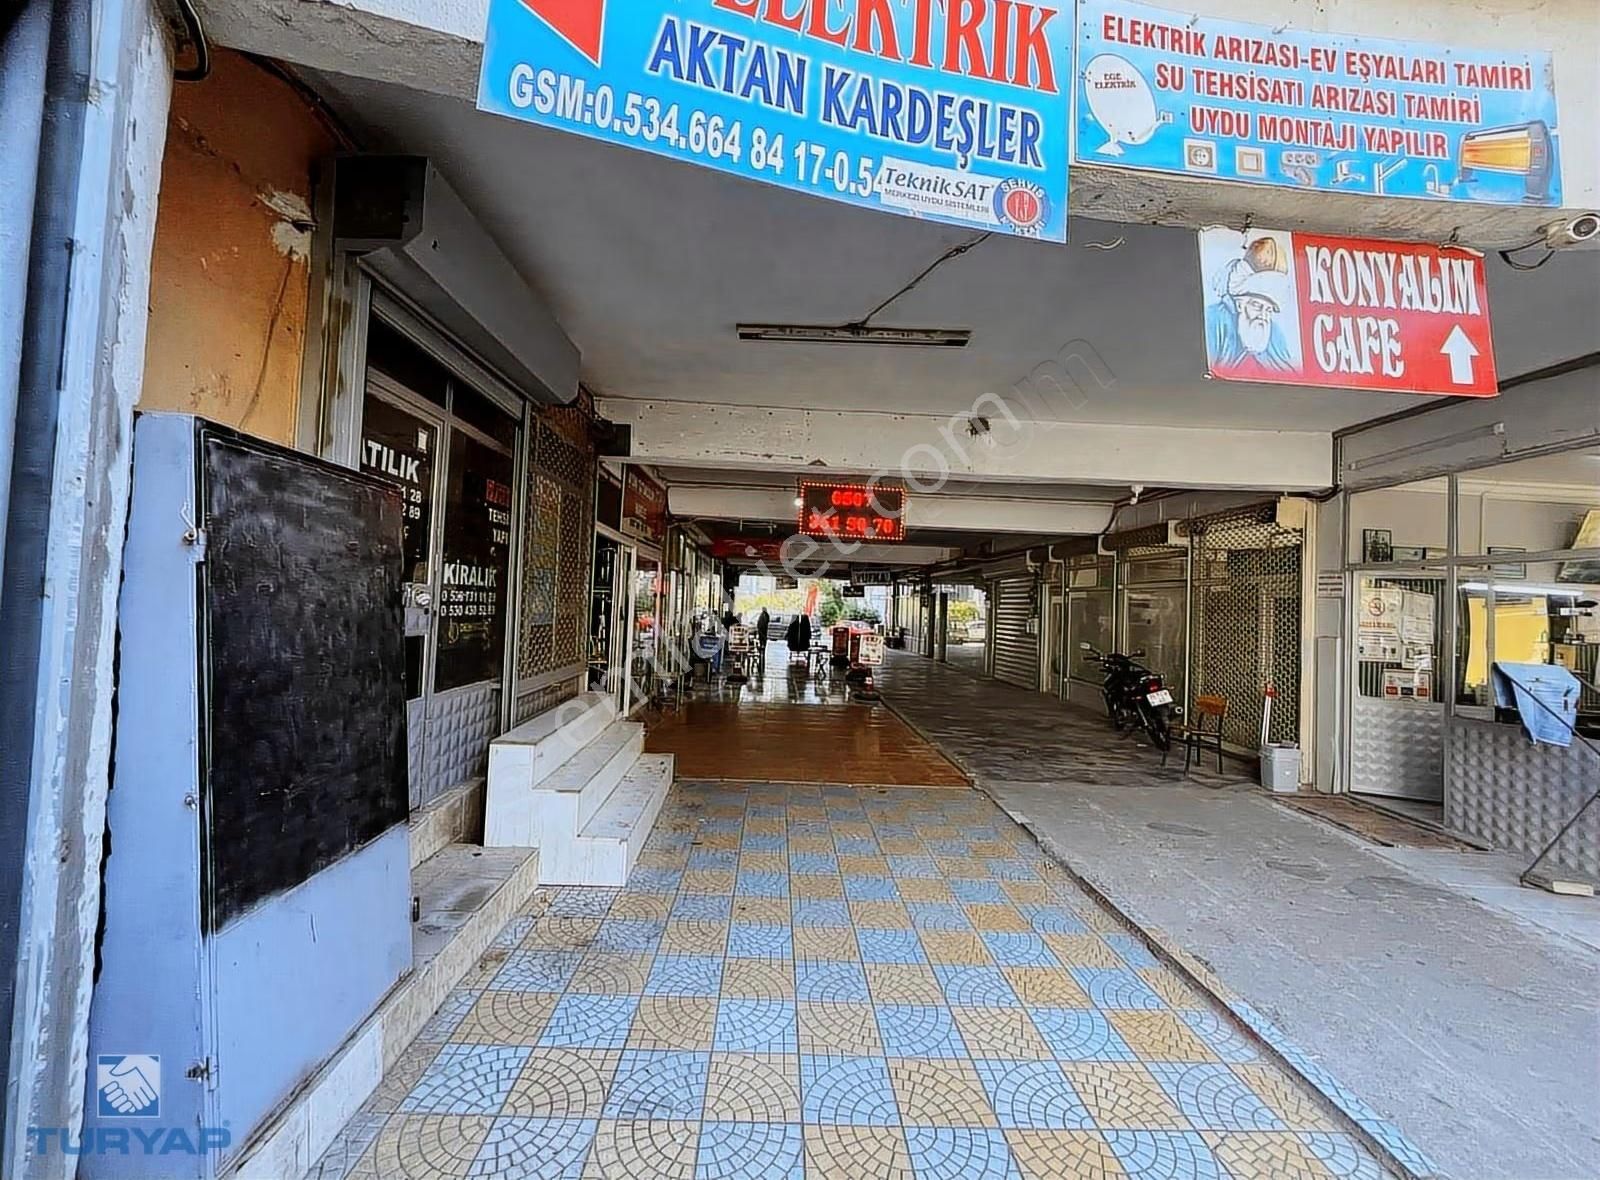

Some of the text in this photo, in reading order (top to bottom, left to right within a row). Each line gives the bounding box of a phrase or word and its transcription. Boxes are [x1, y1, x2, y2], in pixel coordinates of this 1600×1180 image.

[713, 0, 1058, 93] EKTRIK
[1103, 15, 1532, 90] ELEKTRİK ARIZASI-EV EŞYALARI TAMİRİ
[509, 63, 742, 163] GSM:0.534.664
[751, 127, 784, 175] 84
[648, 18, 1043, 169] AKTAN KARDEŞLER
[1156, 63, 1480, 123] SU TEHSİSATI ARIZASI TAMİRİ
[1191, 107, 1448, 158] UYDU MONTAJI YAPILIR
[1305, 245, 1481, 316] KONYALIM
[1313, 314, 1404, 377] CAFE
[443, 559, 496, 587] KİRALIK
